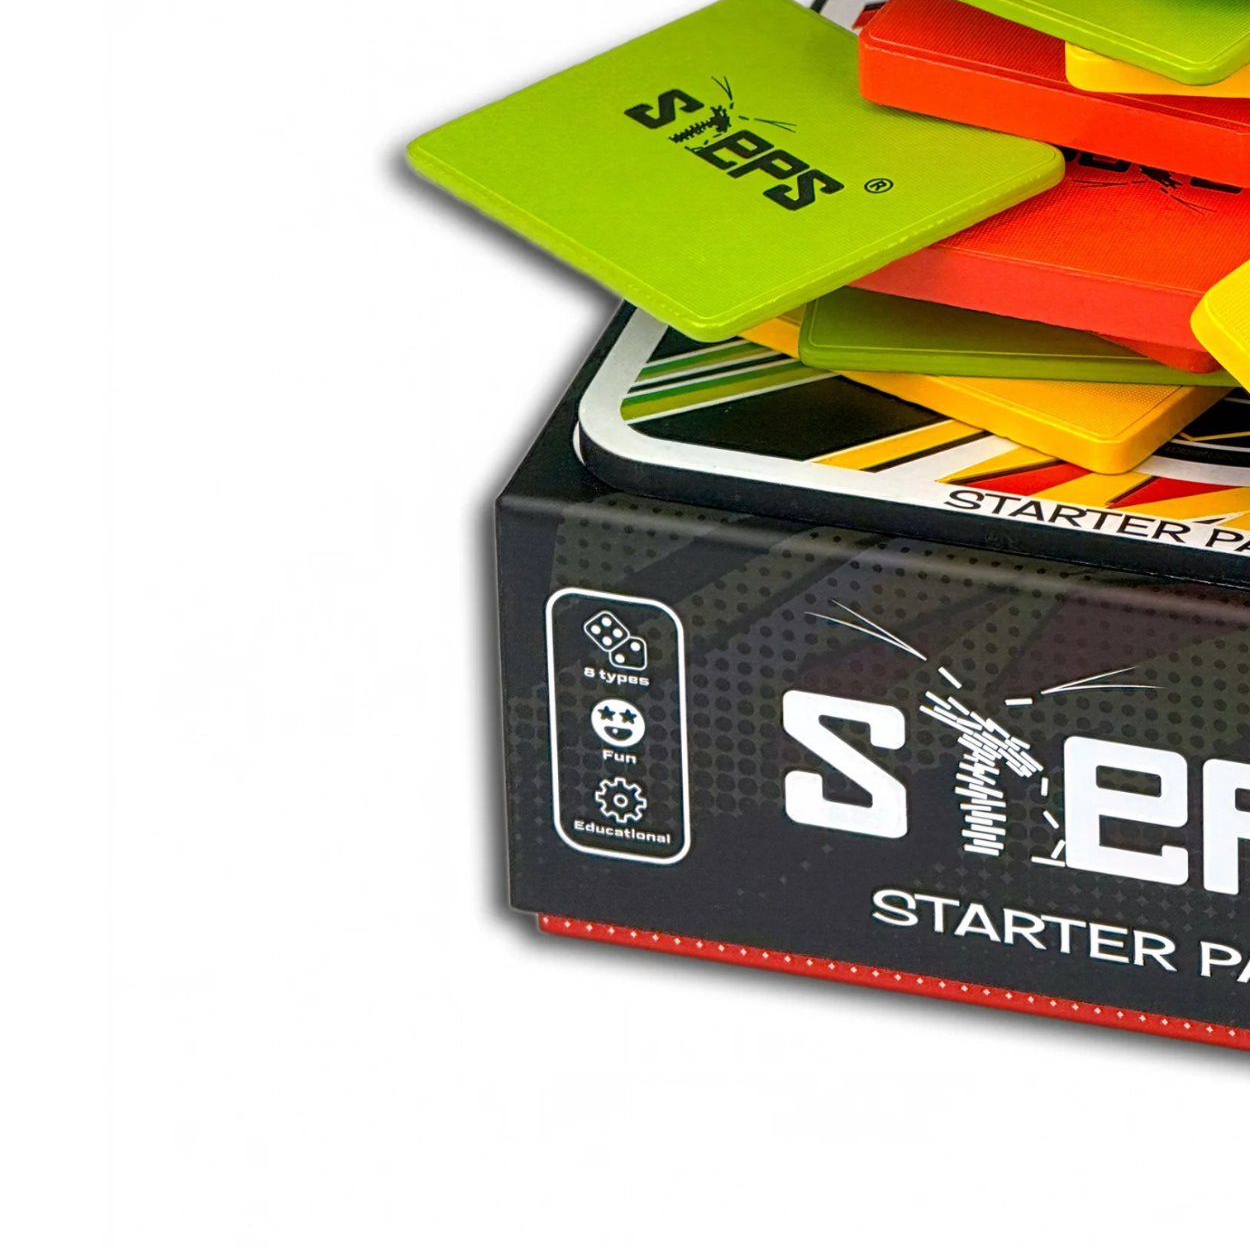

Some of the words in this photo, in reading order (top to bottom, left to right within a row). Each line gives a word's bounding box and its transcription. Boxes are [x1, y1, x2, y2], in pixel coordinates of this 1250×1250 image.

[943, 488, 1193, 544] STARTER
[598, 670, 650, 686] types
[602, 748, 637, 764] Fun
[573, 819, 672, 845] Educational
[871, 888, 1178, 972] STARTER
